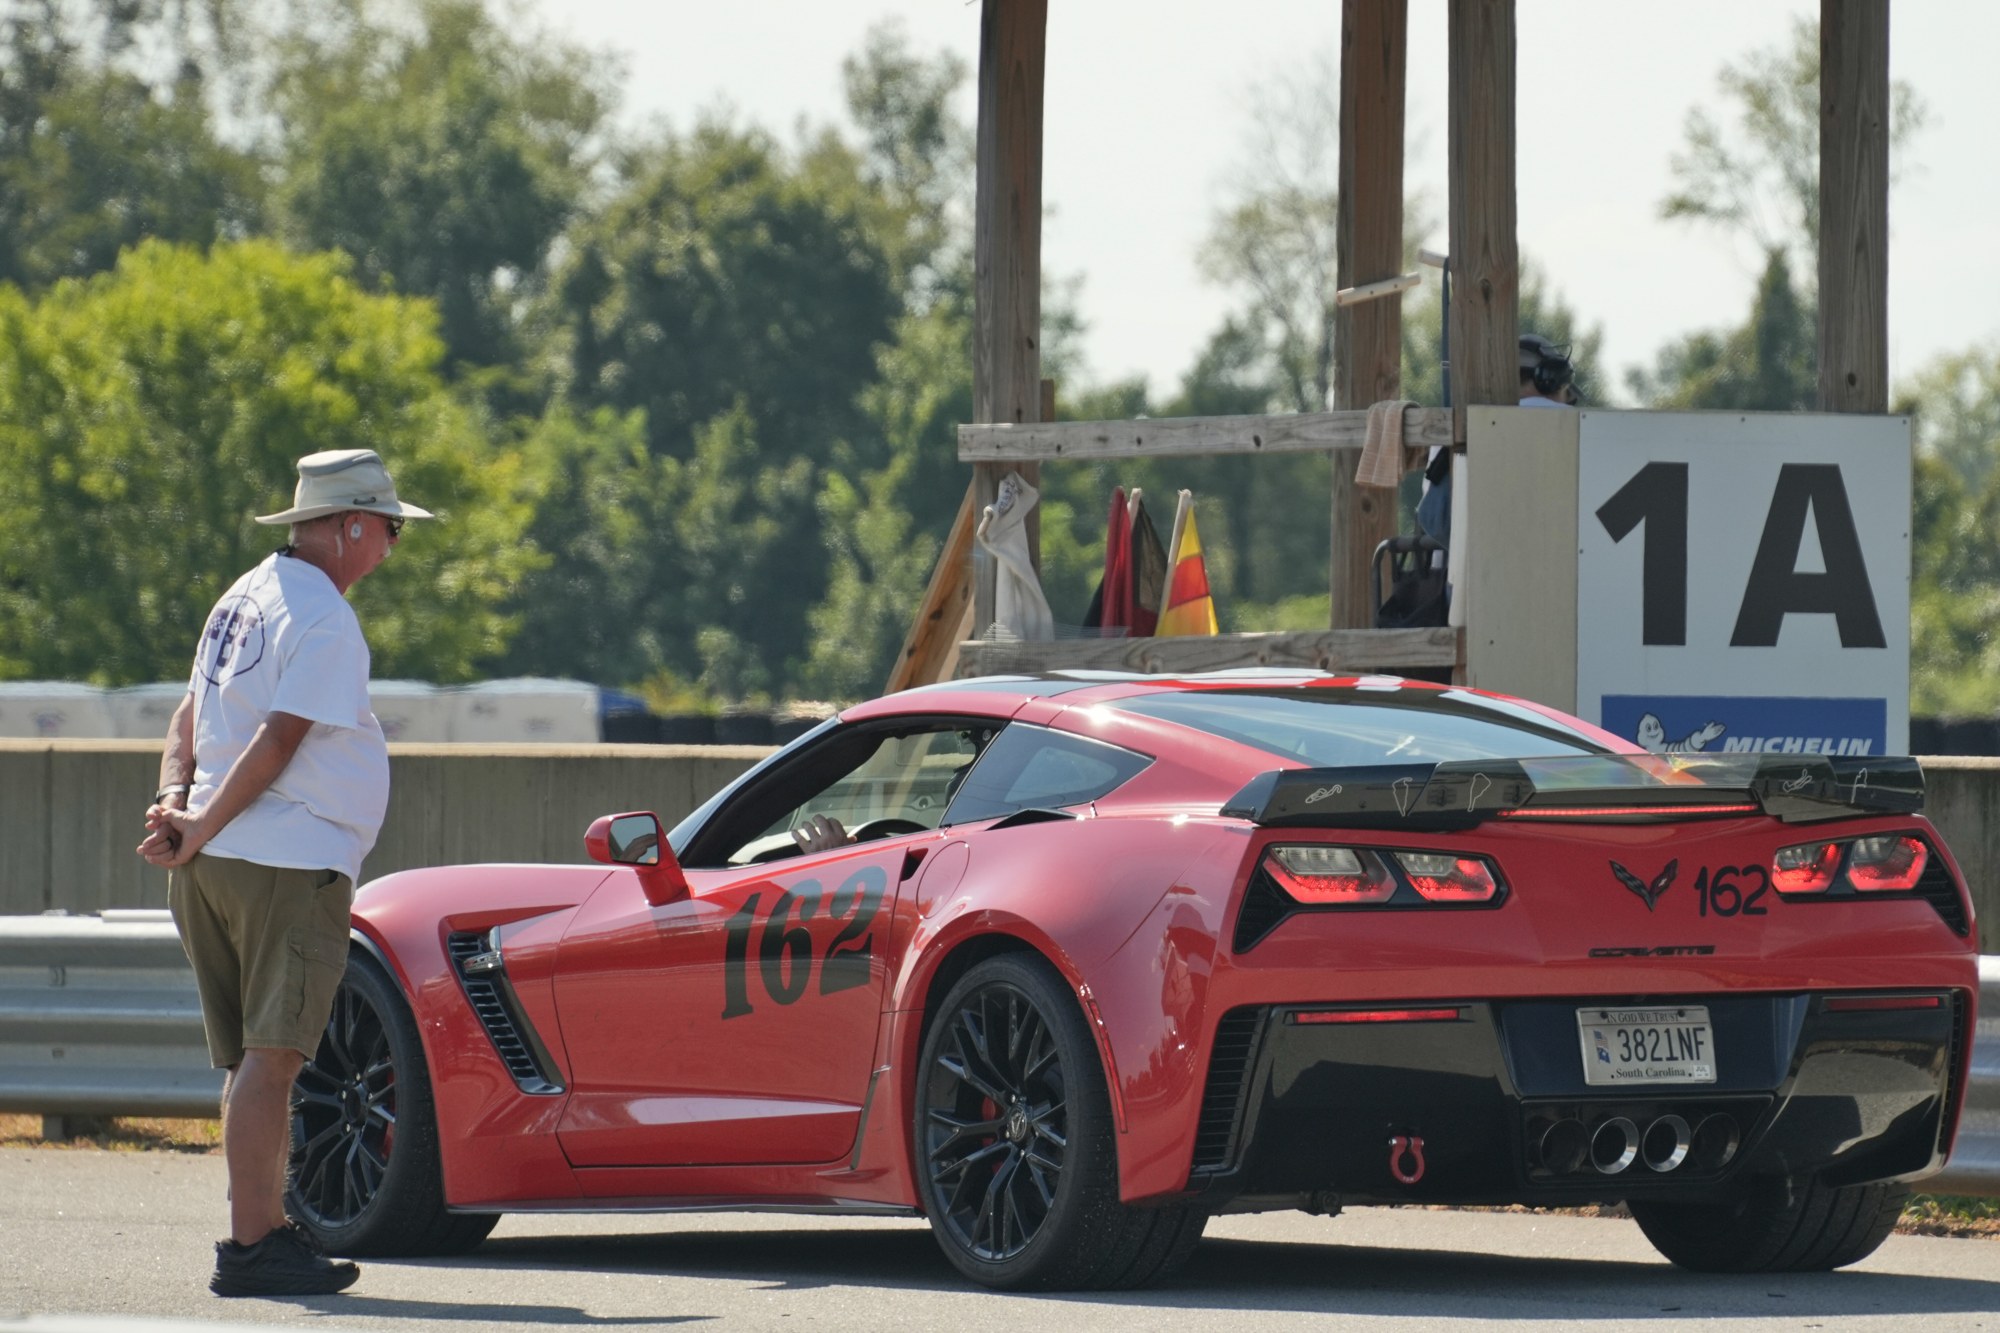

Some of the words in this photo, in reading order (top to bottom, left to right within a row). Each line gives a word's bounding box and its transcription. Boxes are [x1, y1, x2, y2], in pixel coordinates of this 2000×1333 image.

[1595, 461, 1888, 649] 1A
[1723, 736, 1872, 756] MICHELIN
[1694, 864, 1770, 917] 162
[721, 865, 888, 1021] 162
[1618, 1012, 1637, 1023] GOD
[1637, 1011, 1652, 1022] WE
[1653, 1011, 1679, 1022] TRUST
[1617, 1027, 1705, 1062] 3821NF
[1616, 1067, 1645, 1078] South
[1646, 1066, 1686, 1078] Carolina
